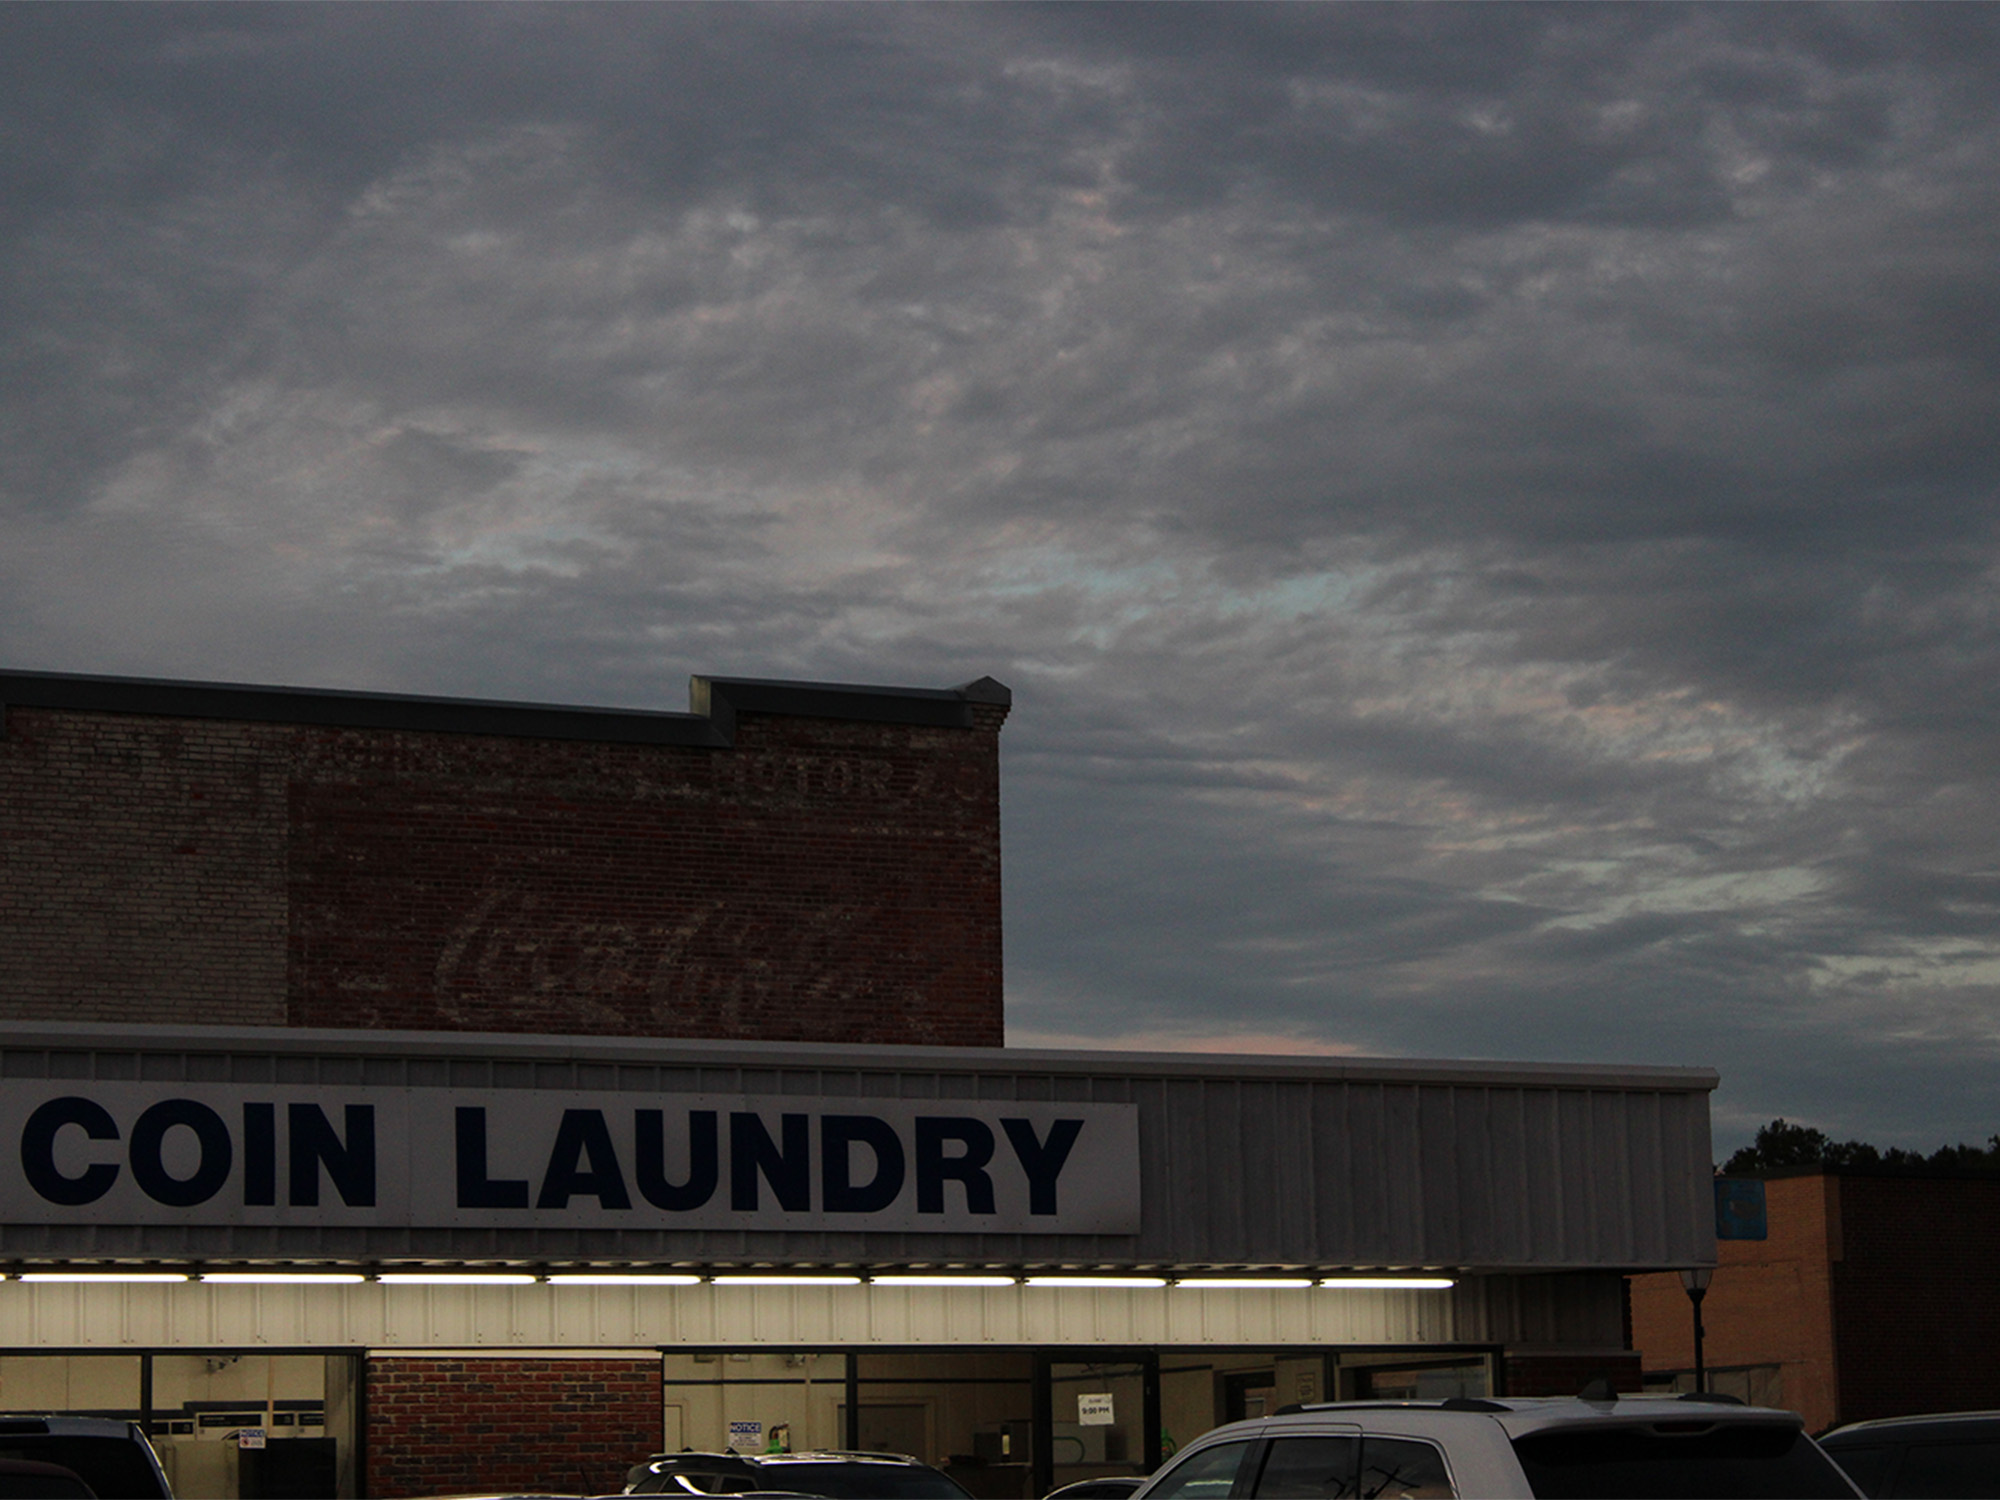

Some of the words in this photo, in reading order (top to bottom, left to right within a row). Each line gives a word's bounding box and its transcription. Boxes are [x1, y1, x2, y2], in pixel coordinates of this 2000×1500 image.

[21, 1097, 376, 1207] COIN
[456, 1106, 1084, 1215] LAUNDRY
[1098, 1406, 1110, 1414] PM
